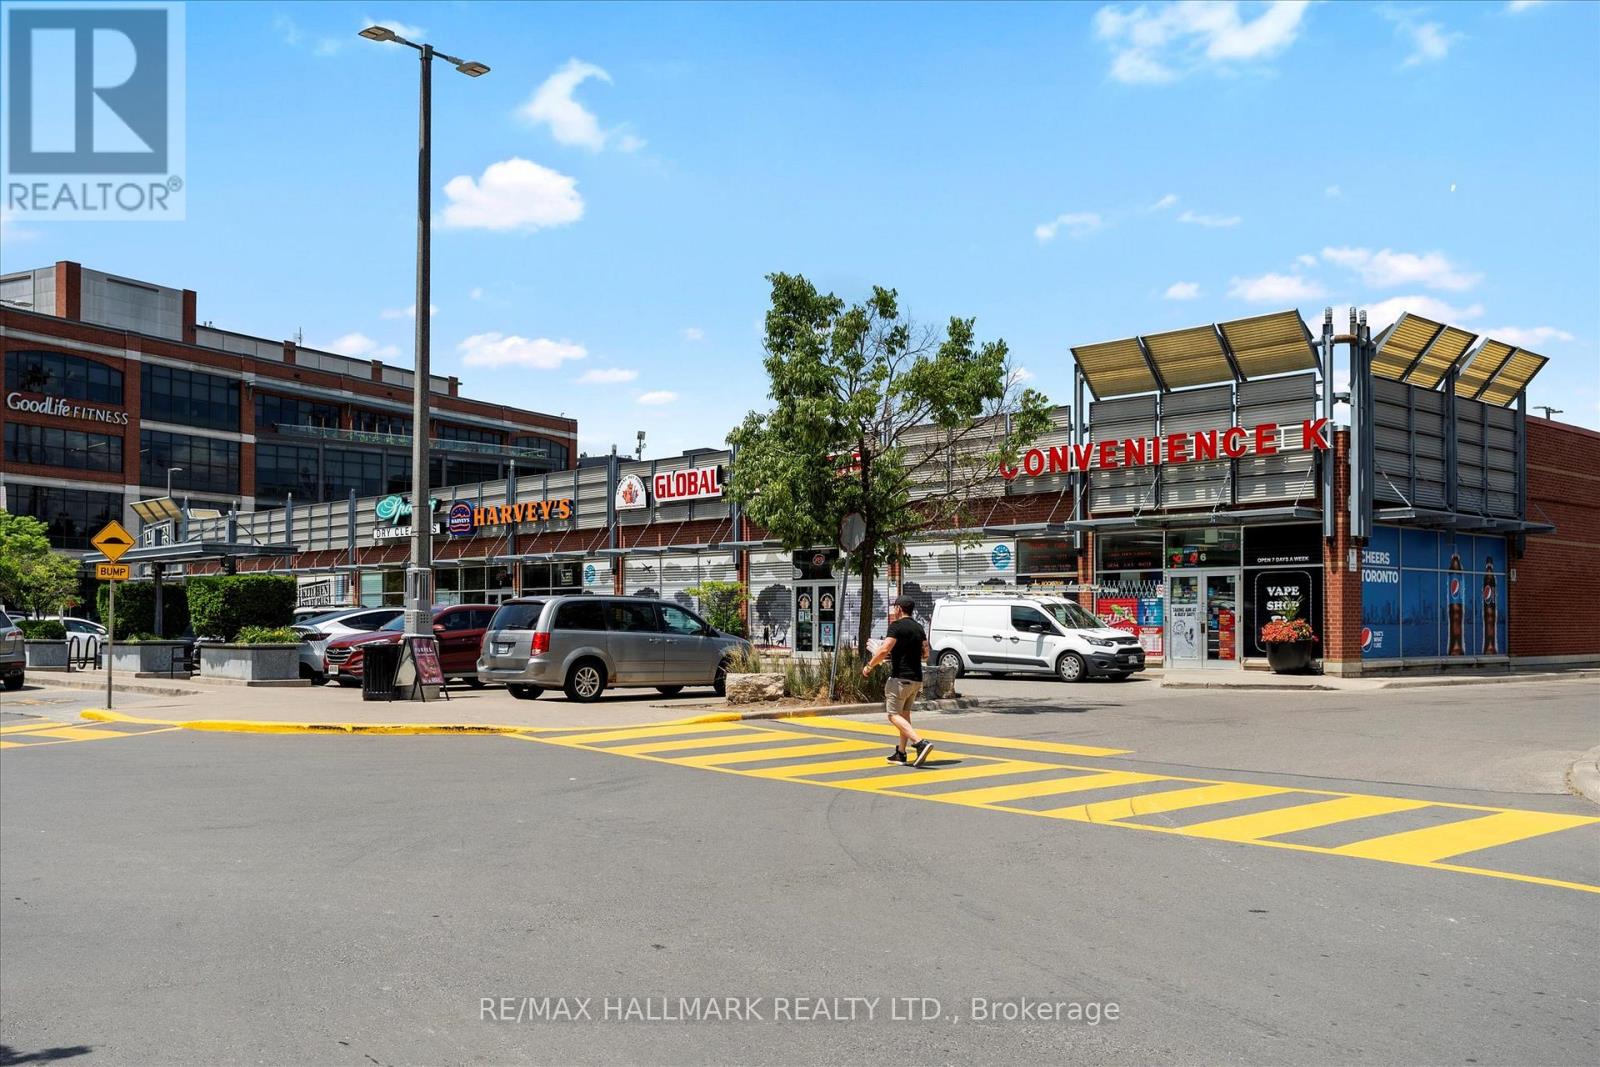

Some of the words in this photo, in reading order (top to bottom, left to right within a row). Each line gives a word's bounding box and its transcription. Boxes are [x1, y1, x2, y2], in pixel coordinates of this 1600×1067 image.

[7, 392, 70, 417] GoodLife
[73, 406, 129, 425] FITNESS
[1302, 417, 1331, 450] K
[655, 469, 720, 499] GLOBAL
[473, 498, 572, 527] HARVEY'S
[376, 528, 391, 538] DRY
[100, 567, 126, 577] BUMP
[1266, 586, 1300, 597] VAPE
[1266, 600, 1300, 611] SHOP
